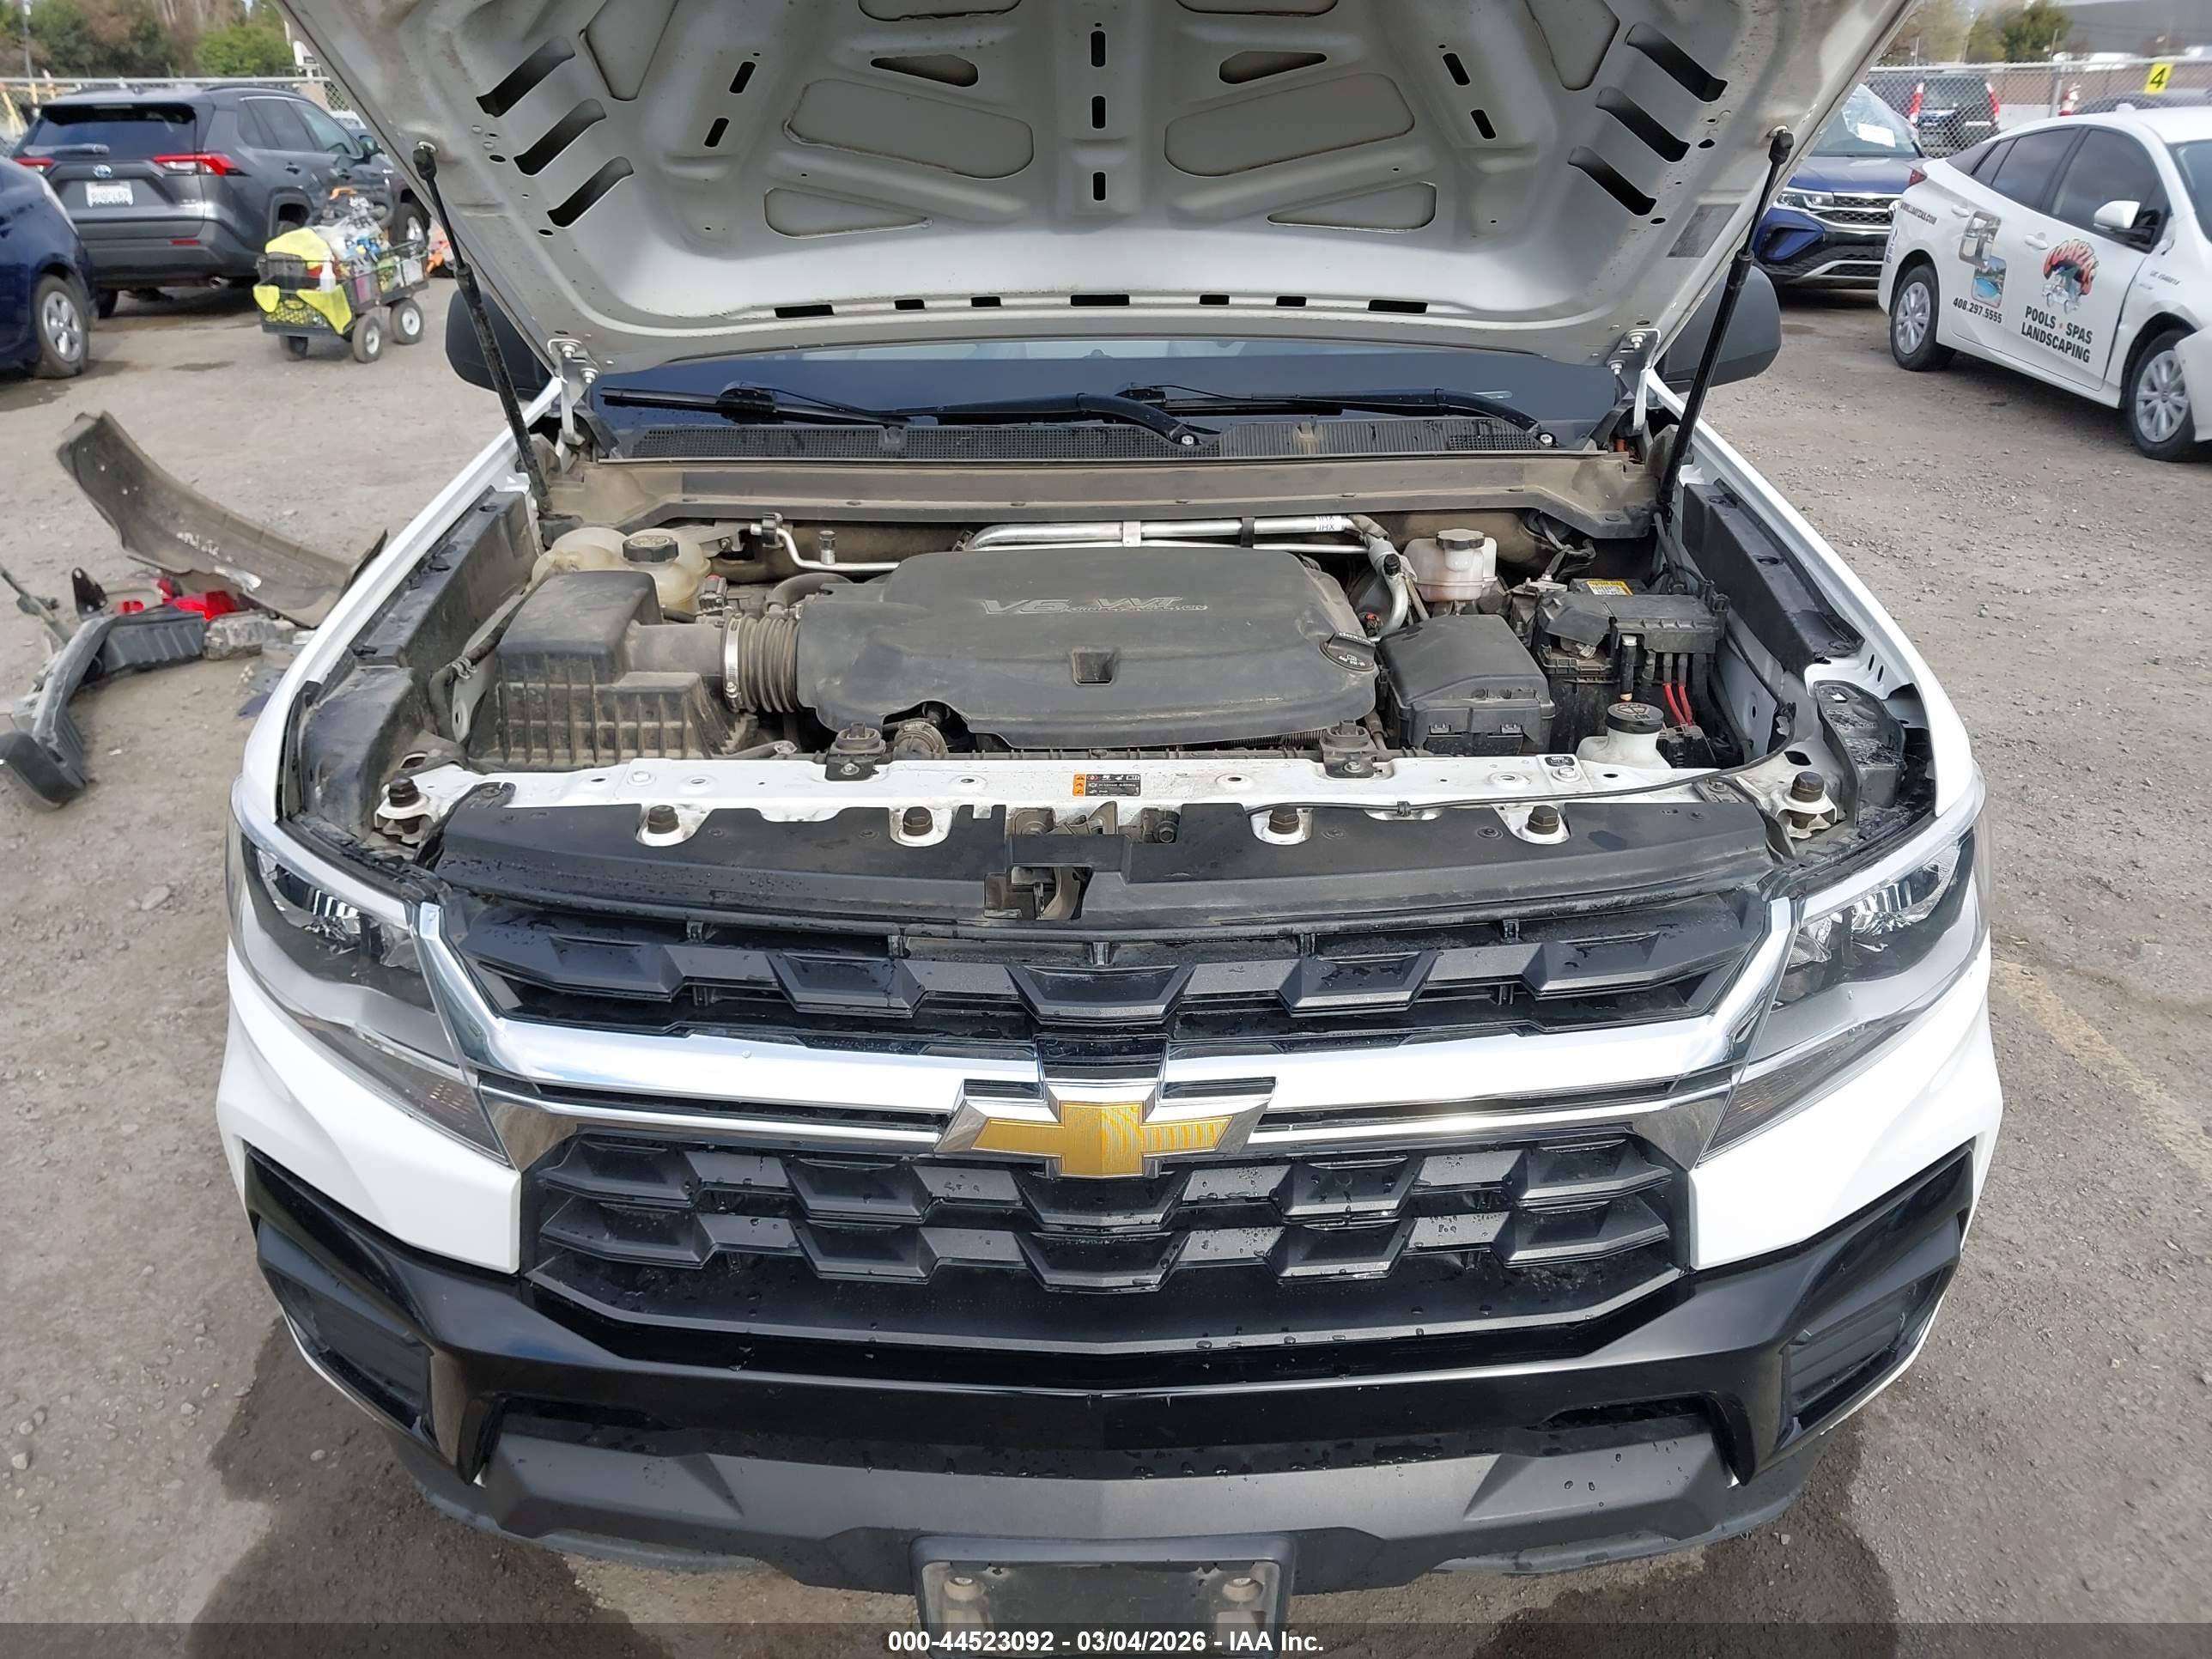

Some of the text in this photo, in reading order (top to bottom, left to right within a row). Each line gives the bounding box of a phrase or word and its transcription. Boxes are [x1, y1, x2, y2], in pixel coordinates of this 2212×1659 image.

[2150, 68, 2166, 88] 4
[1953, 297, 2002, 324] 408.297.5555
[2025, 305, 2093, 344] POOLS SPAS
[2021, 322, 2091, 363] LANDSCAPING
[982, 599, 1072, 615] V6
